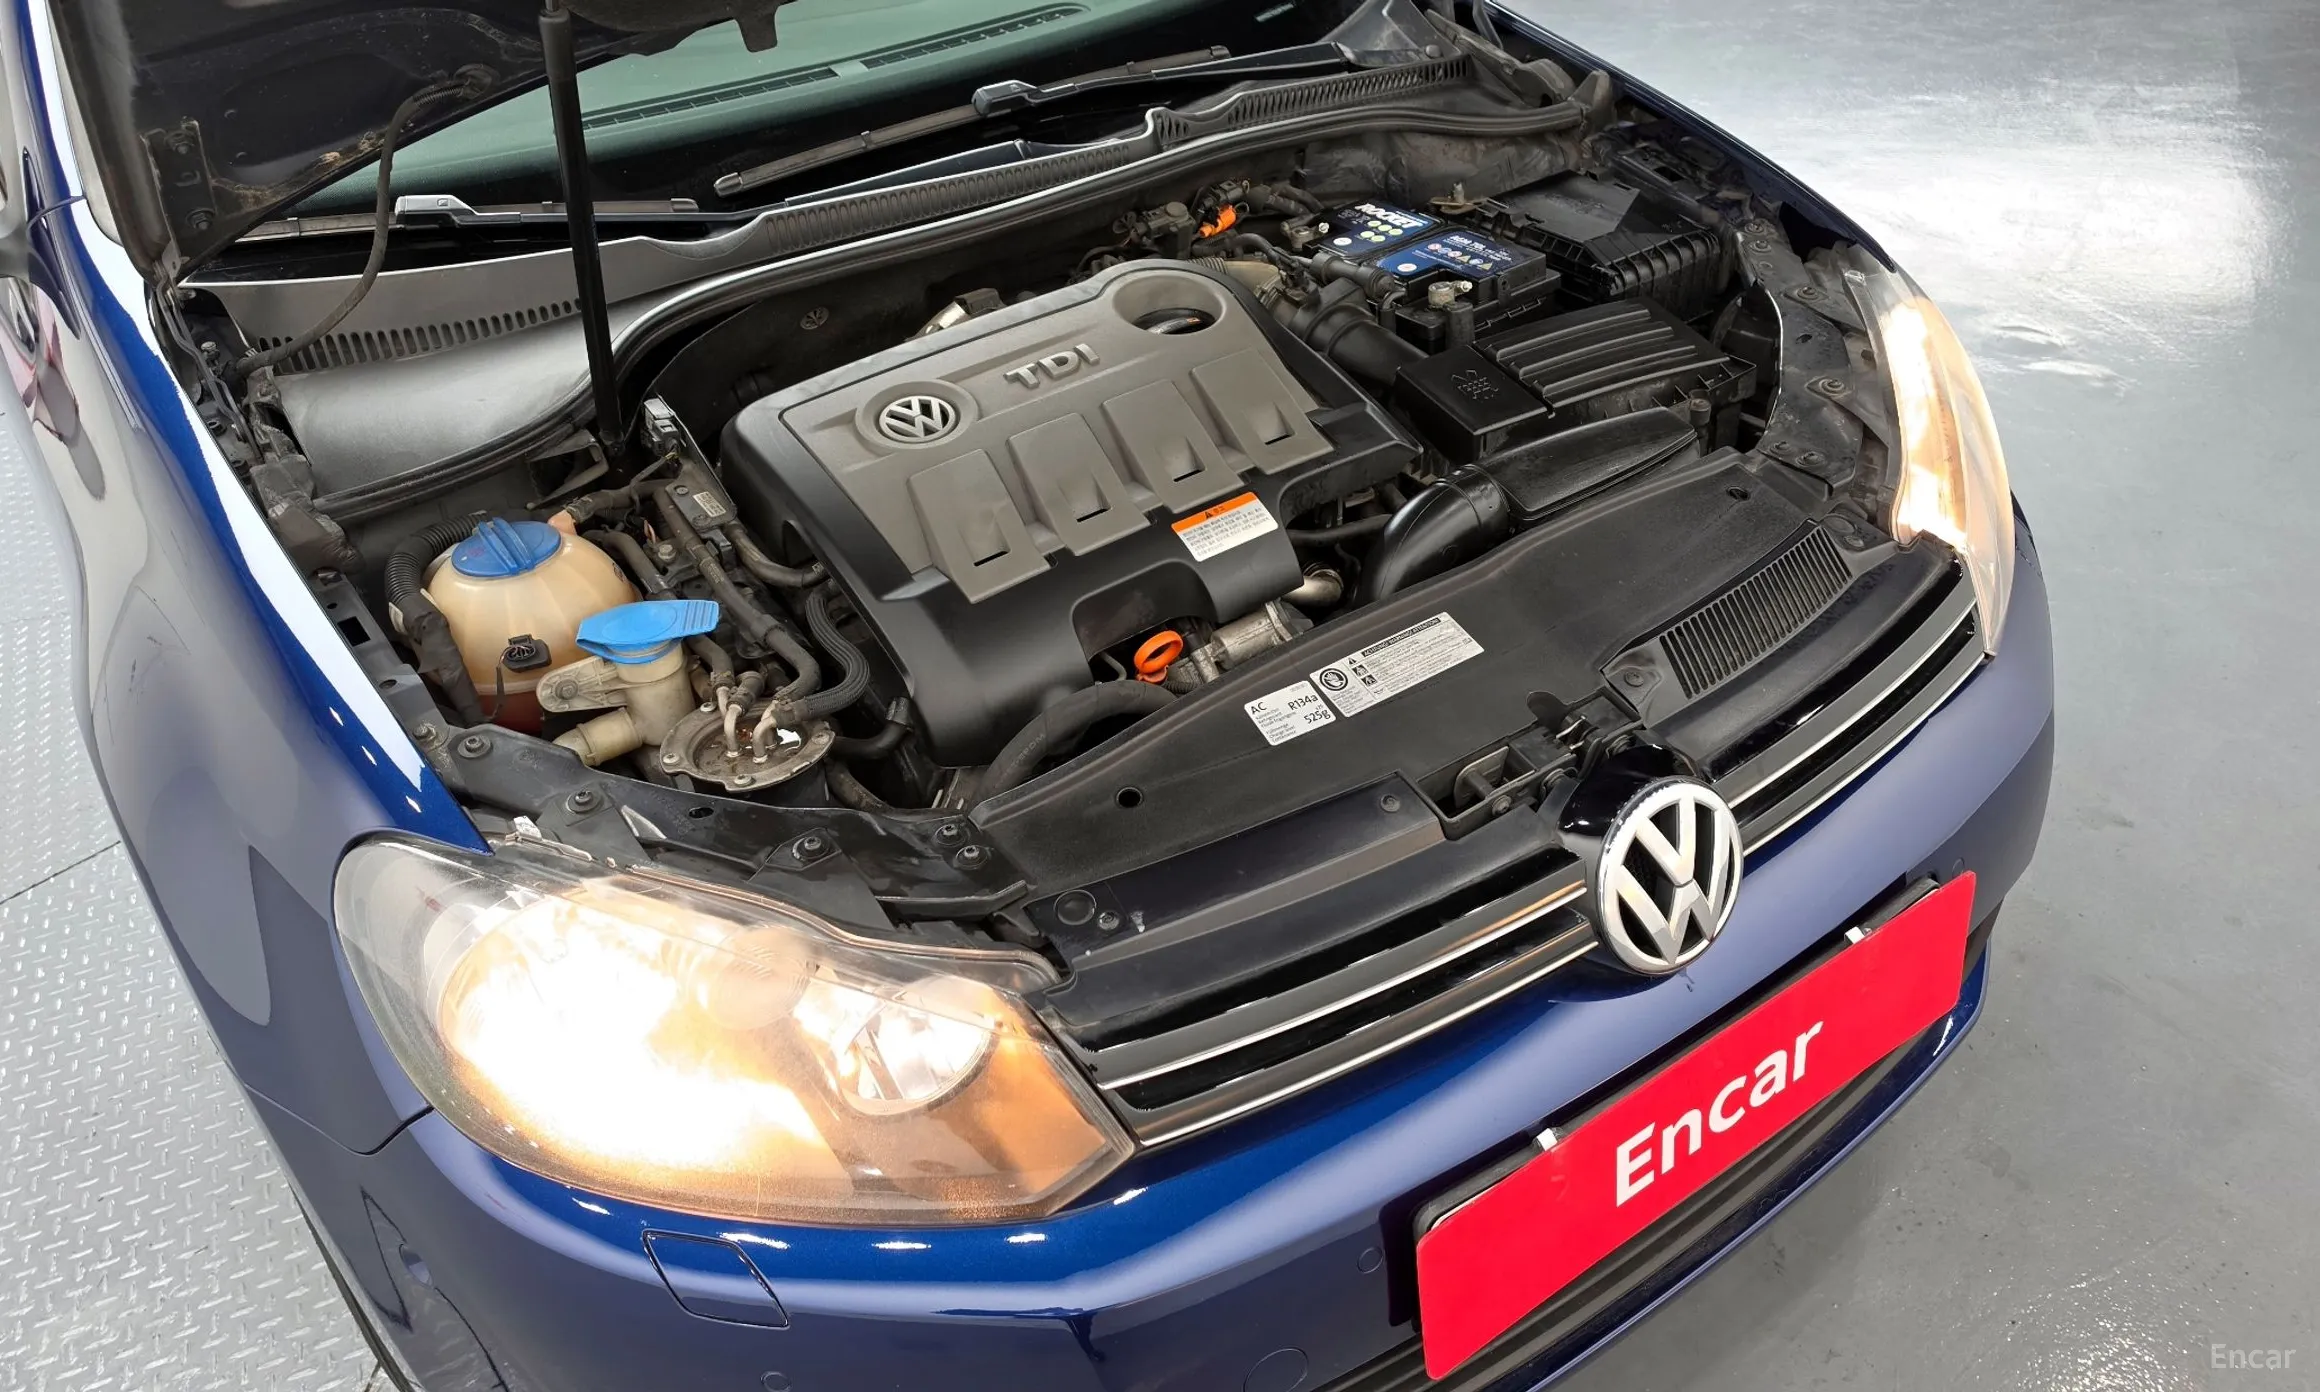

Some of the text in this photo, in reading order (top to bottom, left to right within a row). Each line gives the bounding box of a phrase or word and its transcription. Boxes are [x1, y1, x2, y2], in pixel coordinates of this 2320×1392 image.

[1354, 203, 1423, 229] ROCKET
[1003, 343, 1099, 389] TDI
[1250, 701, 1267, 714] AC
[1287, 694, 1319, 711] R134a
[1303, 709, 1331, 724] 525g
[1616, 1021, 1824, 1208] Encar
